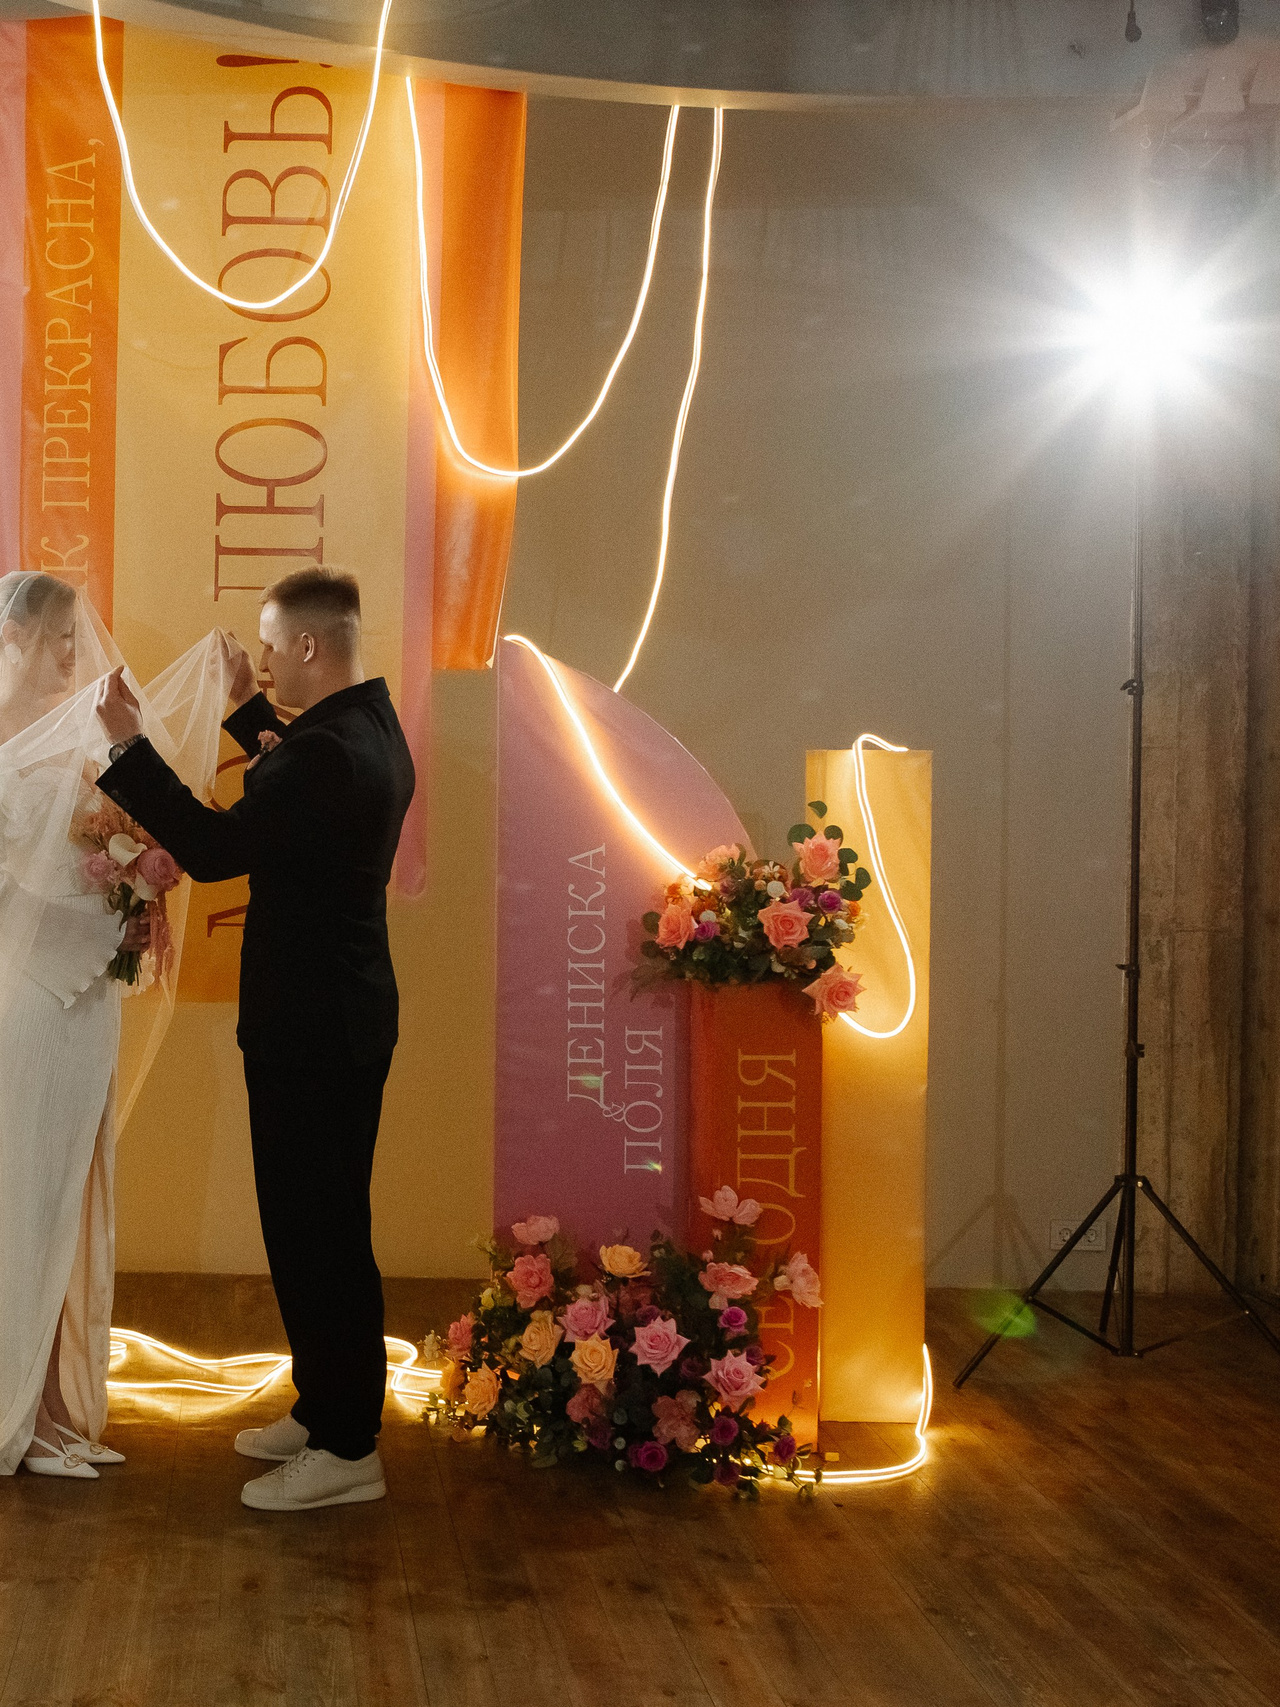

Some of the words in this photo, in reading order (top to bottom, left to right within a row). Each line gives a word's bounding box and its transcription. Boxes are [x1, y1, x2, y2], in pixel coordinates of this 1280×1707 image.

[40, 138, 105, 512] ПРЕКРАСНА,
[214, 53, 334, 602] ЛЮБОВЬ!
[566, 842, 608, 1111] ДЕНИСКА
[623, 1025, 663, 1175] ПОЛЯ
[736, 1048, 807, 1382] СЕОДНЯ
